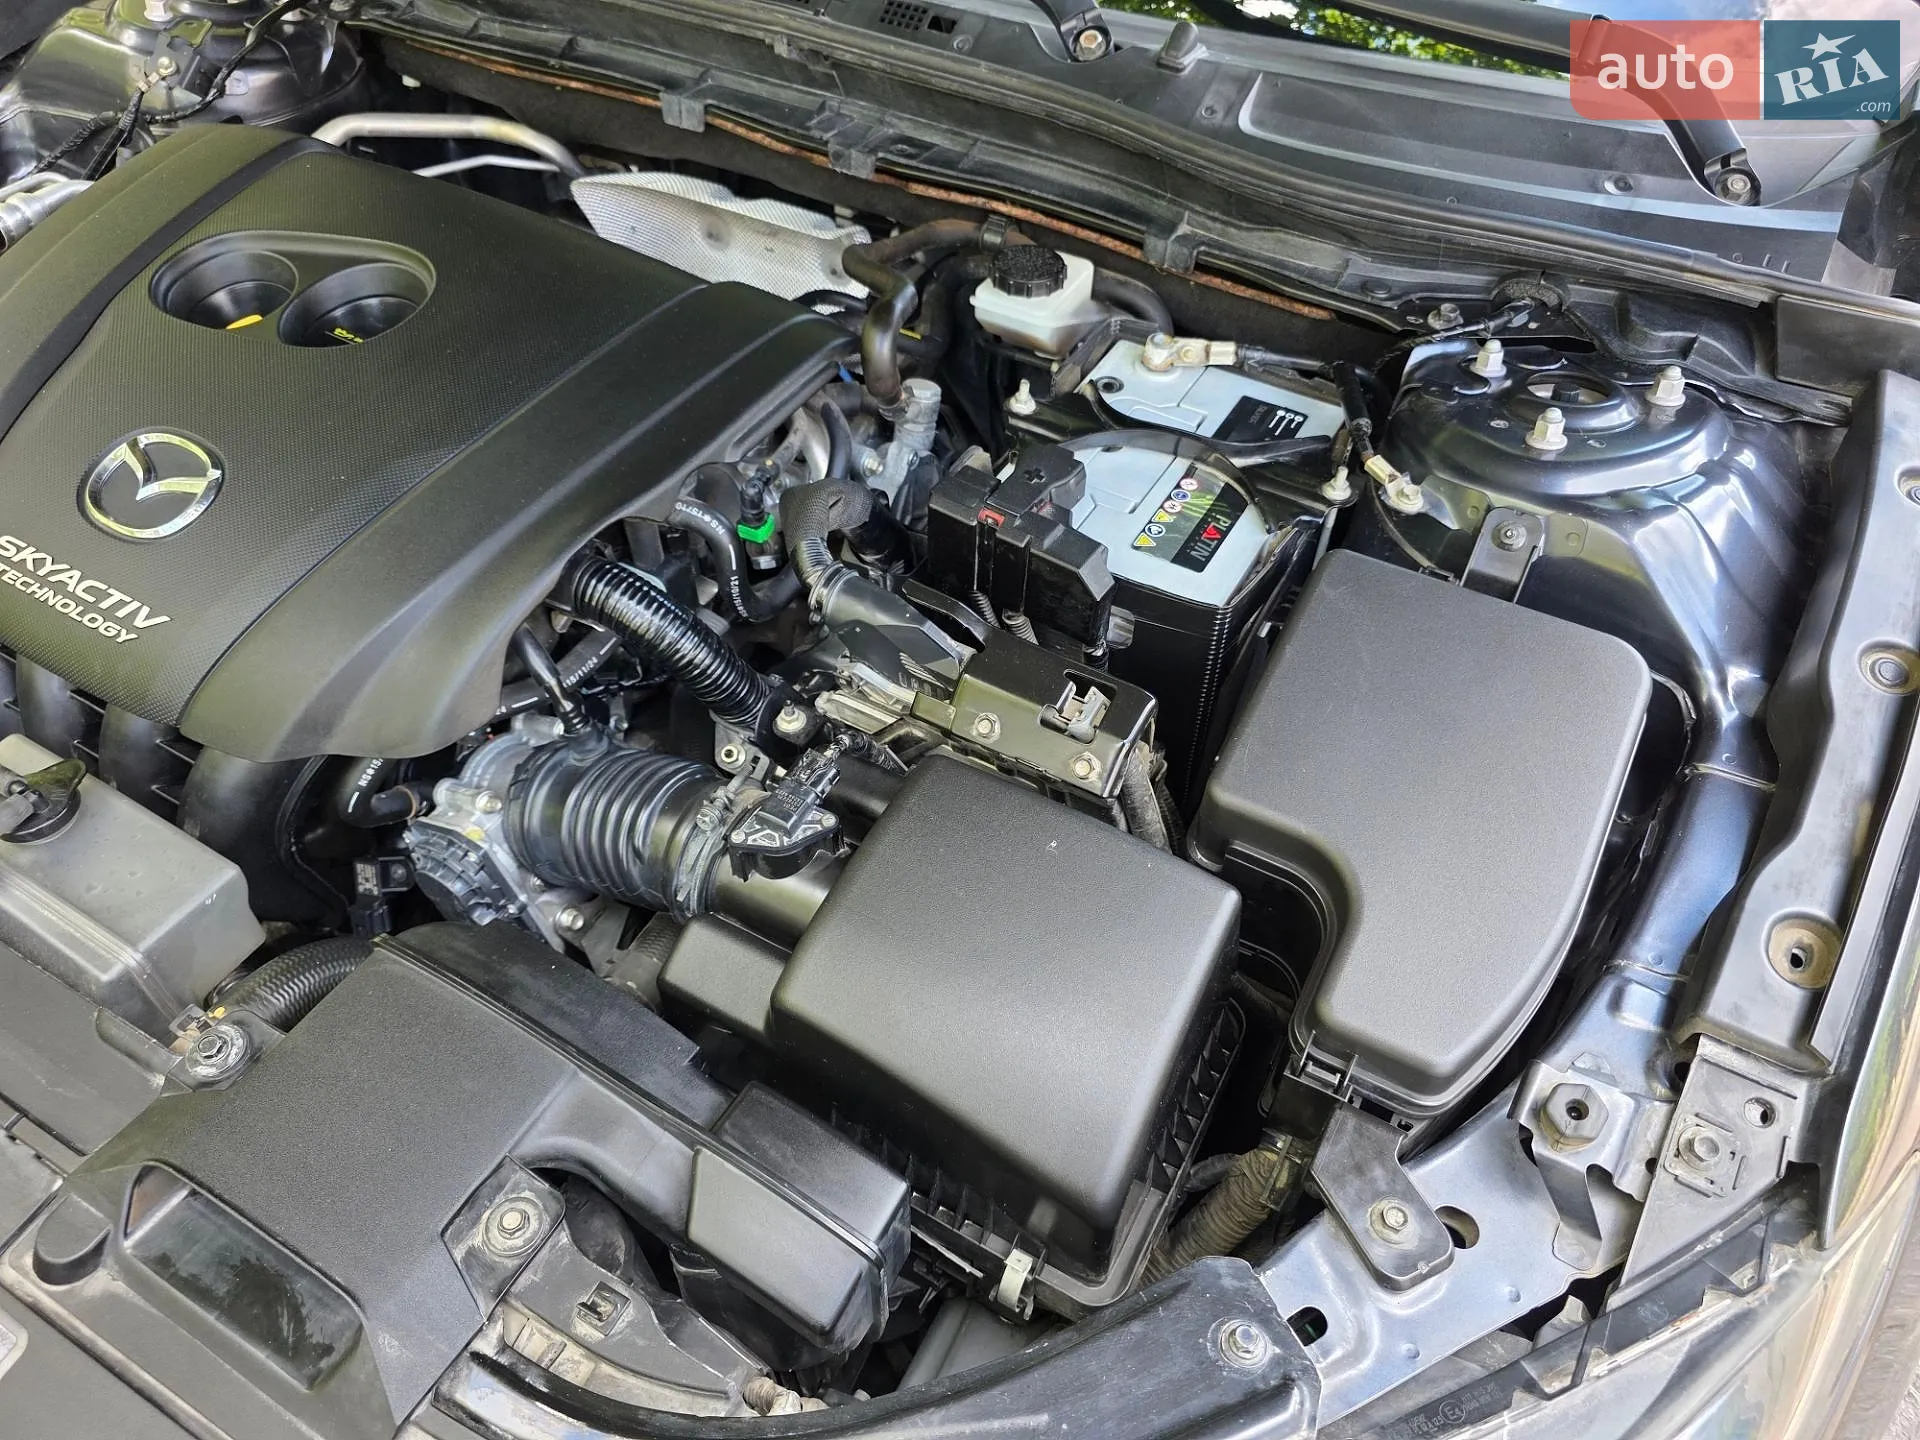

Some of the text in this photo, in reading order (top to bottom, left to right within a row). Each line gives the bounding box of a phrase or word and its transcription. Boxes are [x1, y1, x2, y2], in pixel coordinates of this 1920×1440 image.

[1190, 513, 1231, 561] PLATIN
[0, 535, 172, 629] SKYACTIV
[0, 563, 138, 643] TECHNOLOGY
